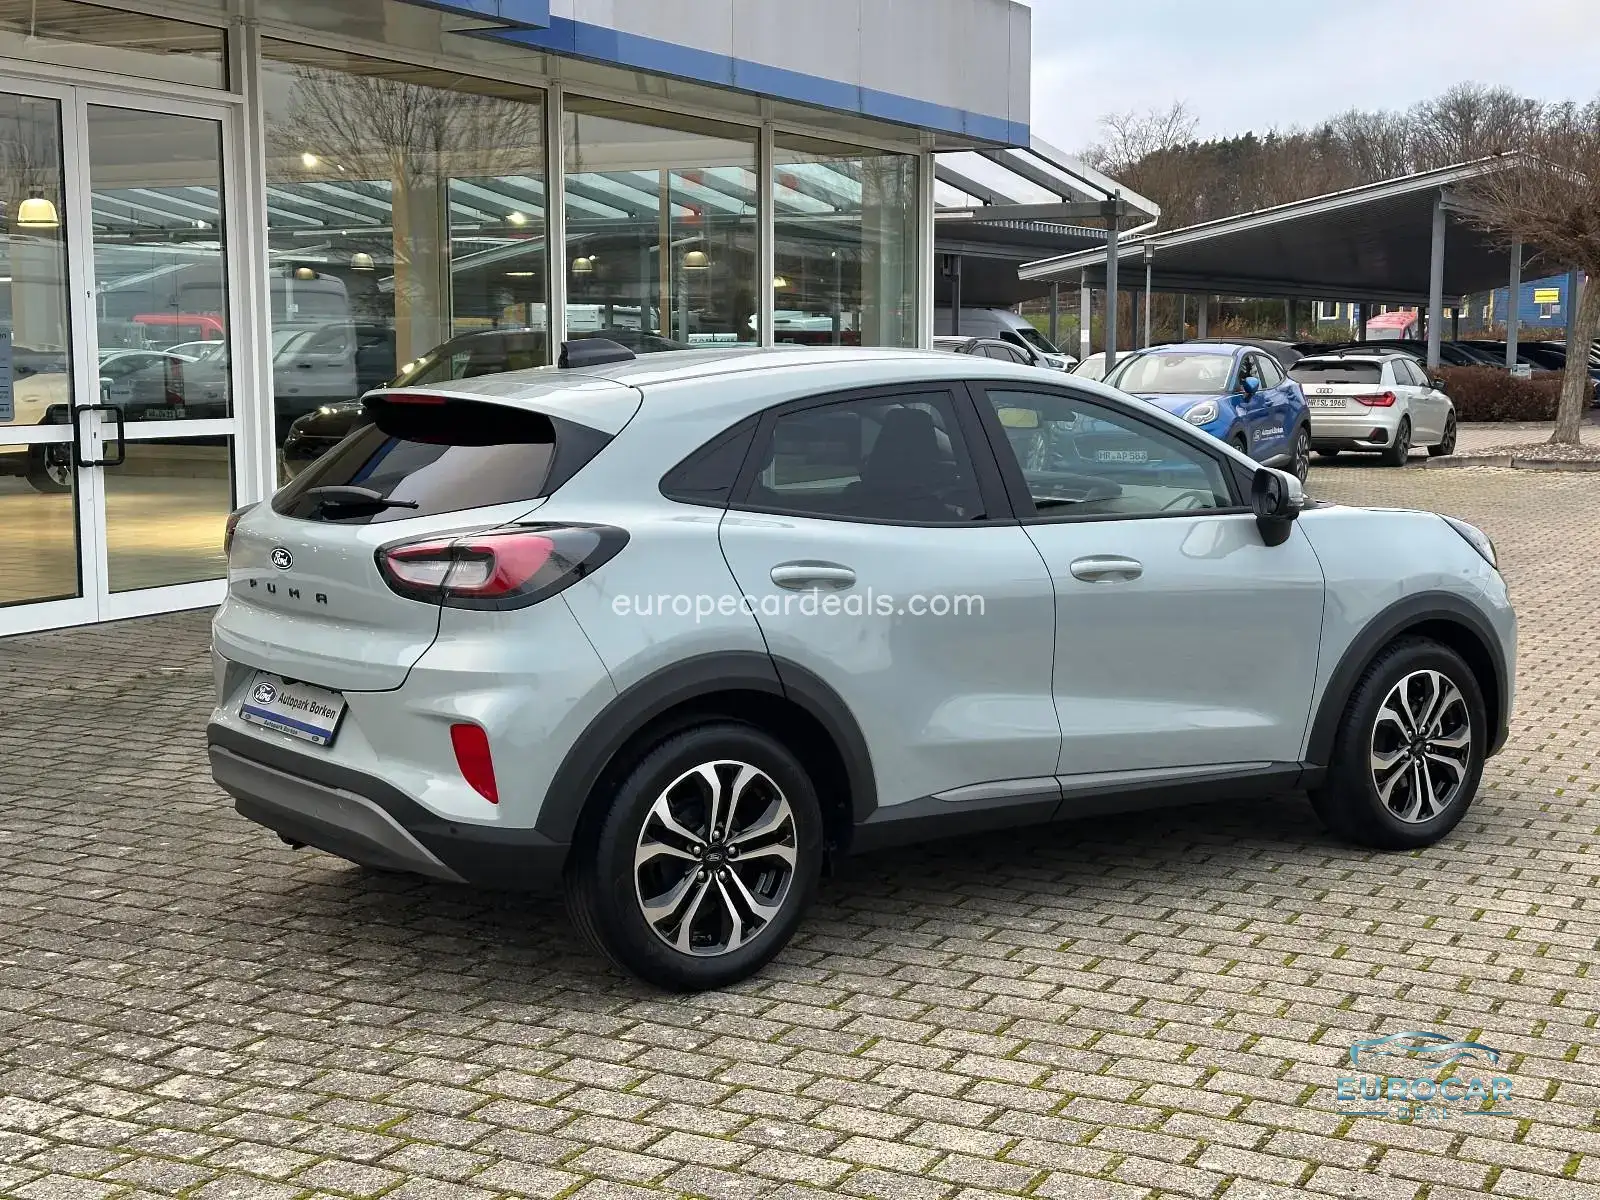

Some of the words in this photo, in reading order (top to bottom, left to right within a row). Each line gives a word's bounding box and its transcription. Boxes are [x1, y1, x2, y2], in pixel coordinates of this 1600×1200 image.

[249, 578, 328, 605] PUMA
[255, 685, 275, 702] Ford
[278, 692, 309, 710] Autopark
[309, 701, 336, 719] Borken
